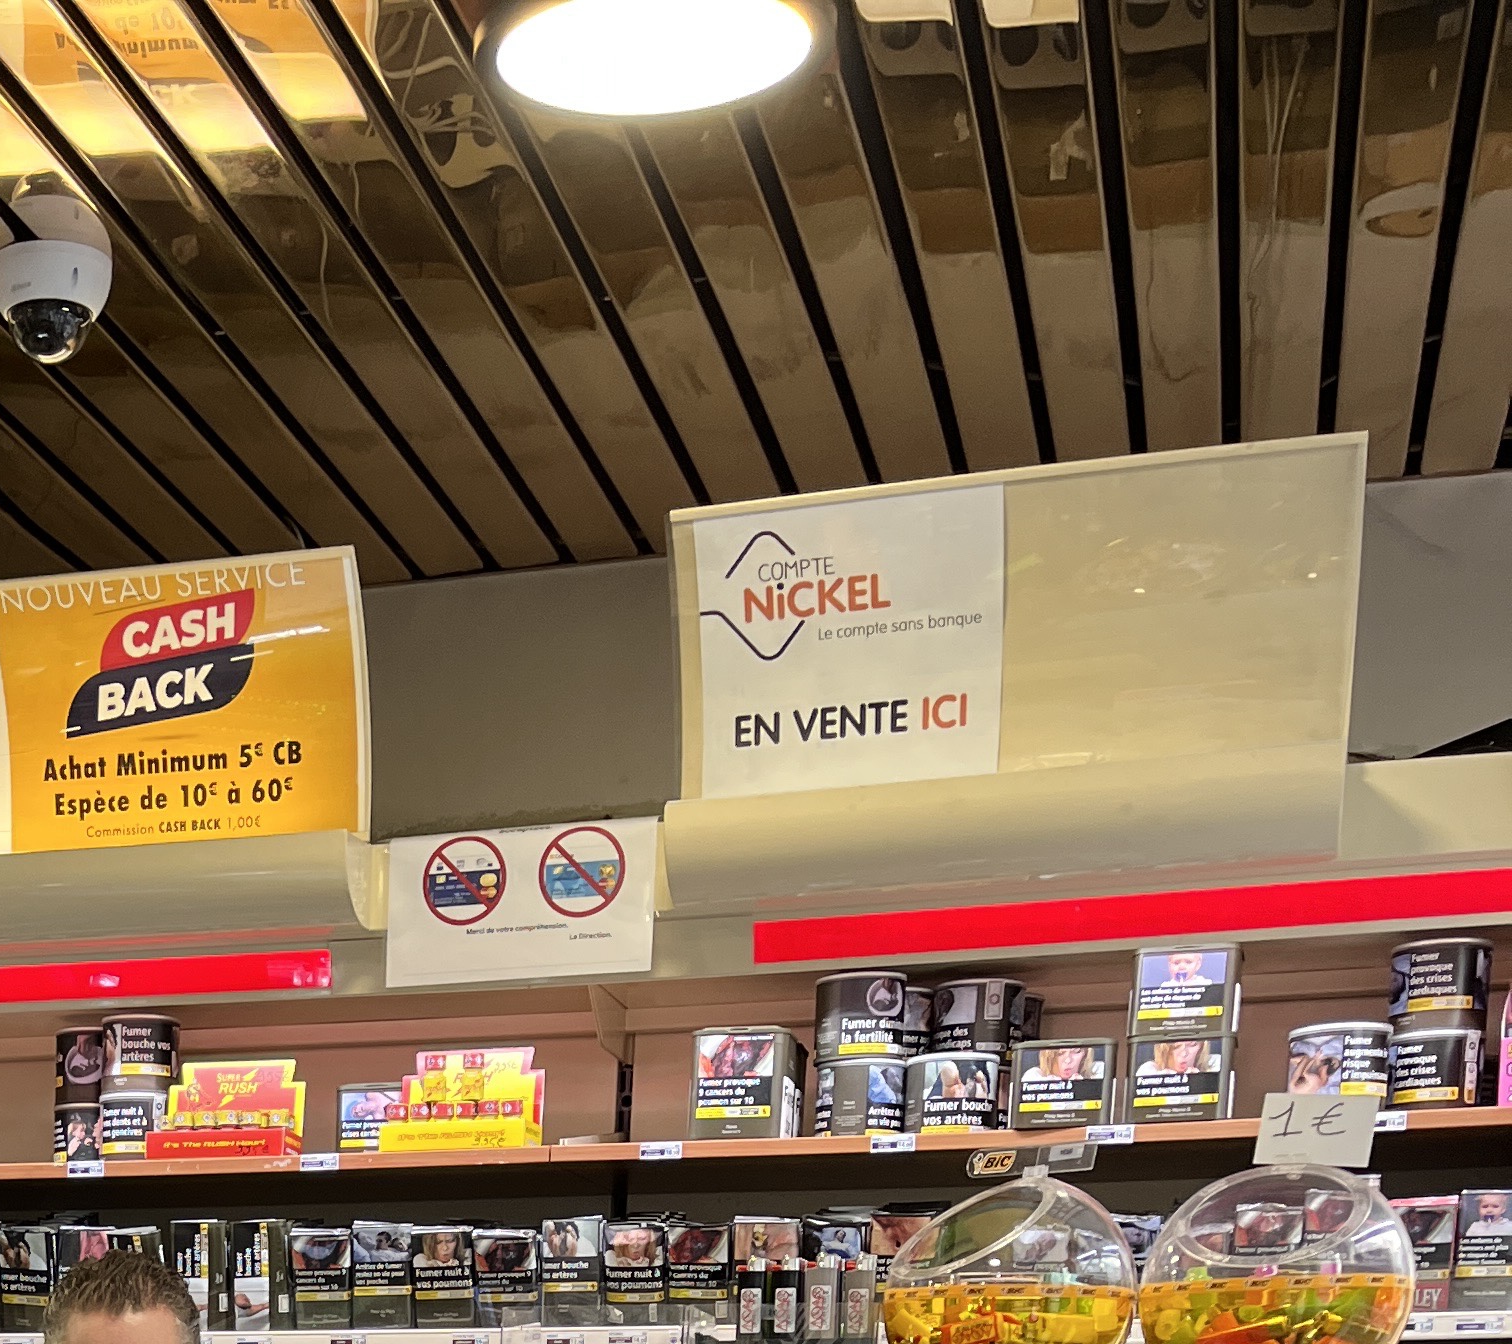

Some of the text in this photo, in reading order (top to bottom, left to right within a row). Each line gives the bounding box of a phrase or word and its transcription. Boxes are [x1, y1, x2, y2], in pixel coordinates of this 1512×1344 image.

[758, 557, 835, 582] COMPTE
[1, 562, 306, 614] NOUVEAU SERVICE
[122, 602, 236, 658] CASH
[819, 612, 982, 640] Le compte sans banque
[98, 664, 213, 721] BACK
[735, 693, 967, 747] EN VENTE ICI
[44, 742, 302, 782] Achat Minimum 5€ CB
[55, 776, 294, 820] Espèce de 10€ à 60€
[86, 823, 154, 838] Commission
[158, 820, 187, 834] CASH
[191, 818, 220, 832] BACK
[1411, 963, 1453, 976] provoque
[1410, 973, 1452, 985] des crises
[1409, 984, 1457, 996] cardiaques
[842, 1018, 877, 1030] Fumer
[122, 1026, 151, 1036] Fumer
[842, 1030, 894, 1044] la fertilité
[122, 1038, 170, 1050] bouche vos
[122, 1051, 154, 1062] artères
[219, 1082, 259, 1094] RUSH
[924, 1100, 960, 1112] Fumer
[924, 1114, 982, 1126] vos artères
[1269, 1101, 1346, 1137] 1 €
[984, 1155, 1011, 1168] BIC
